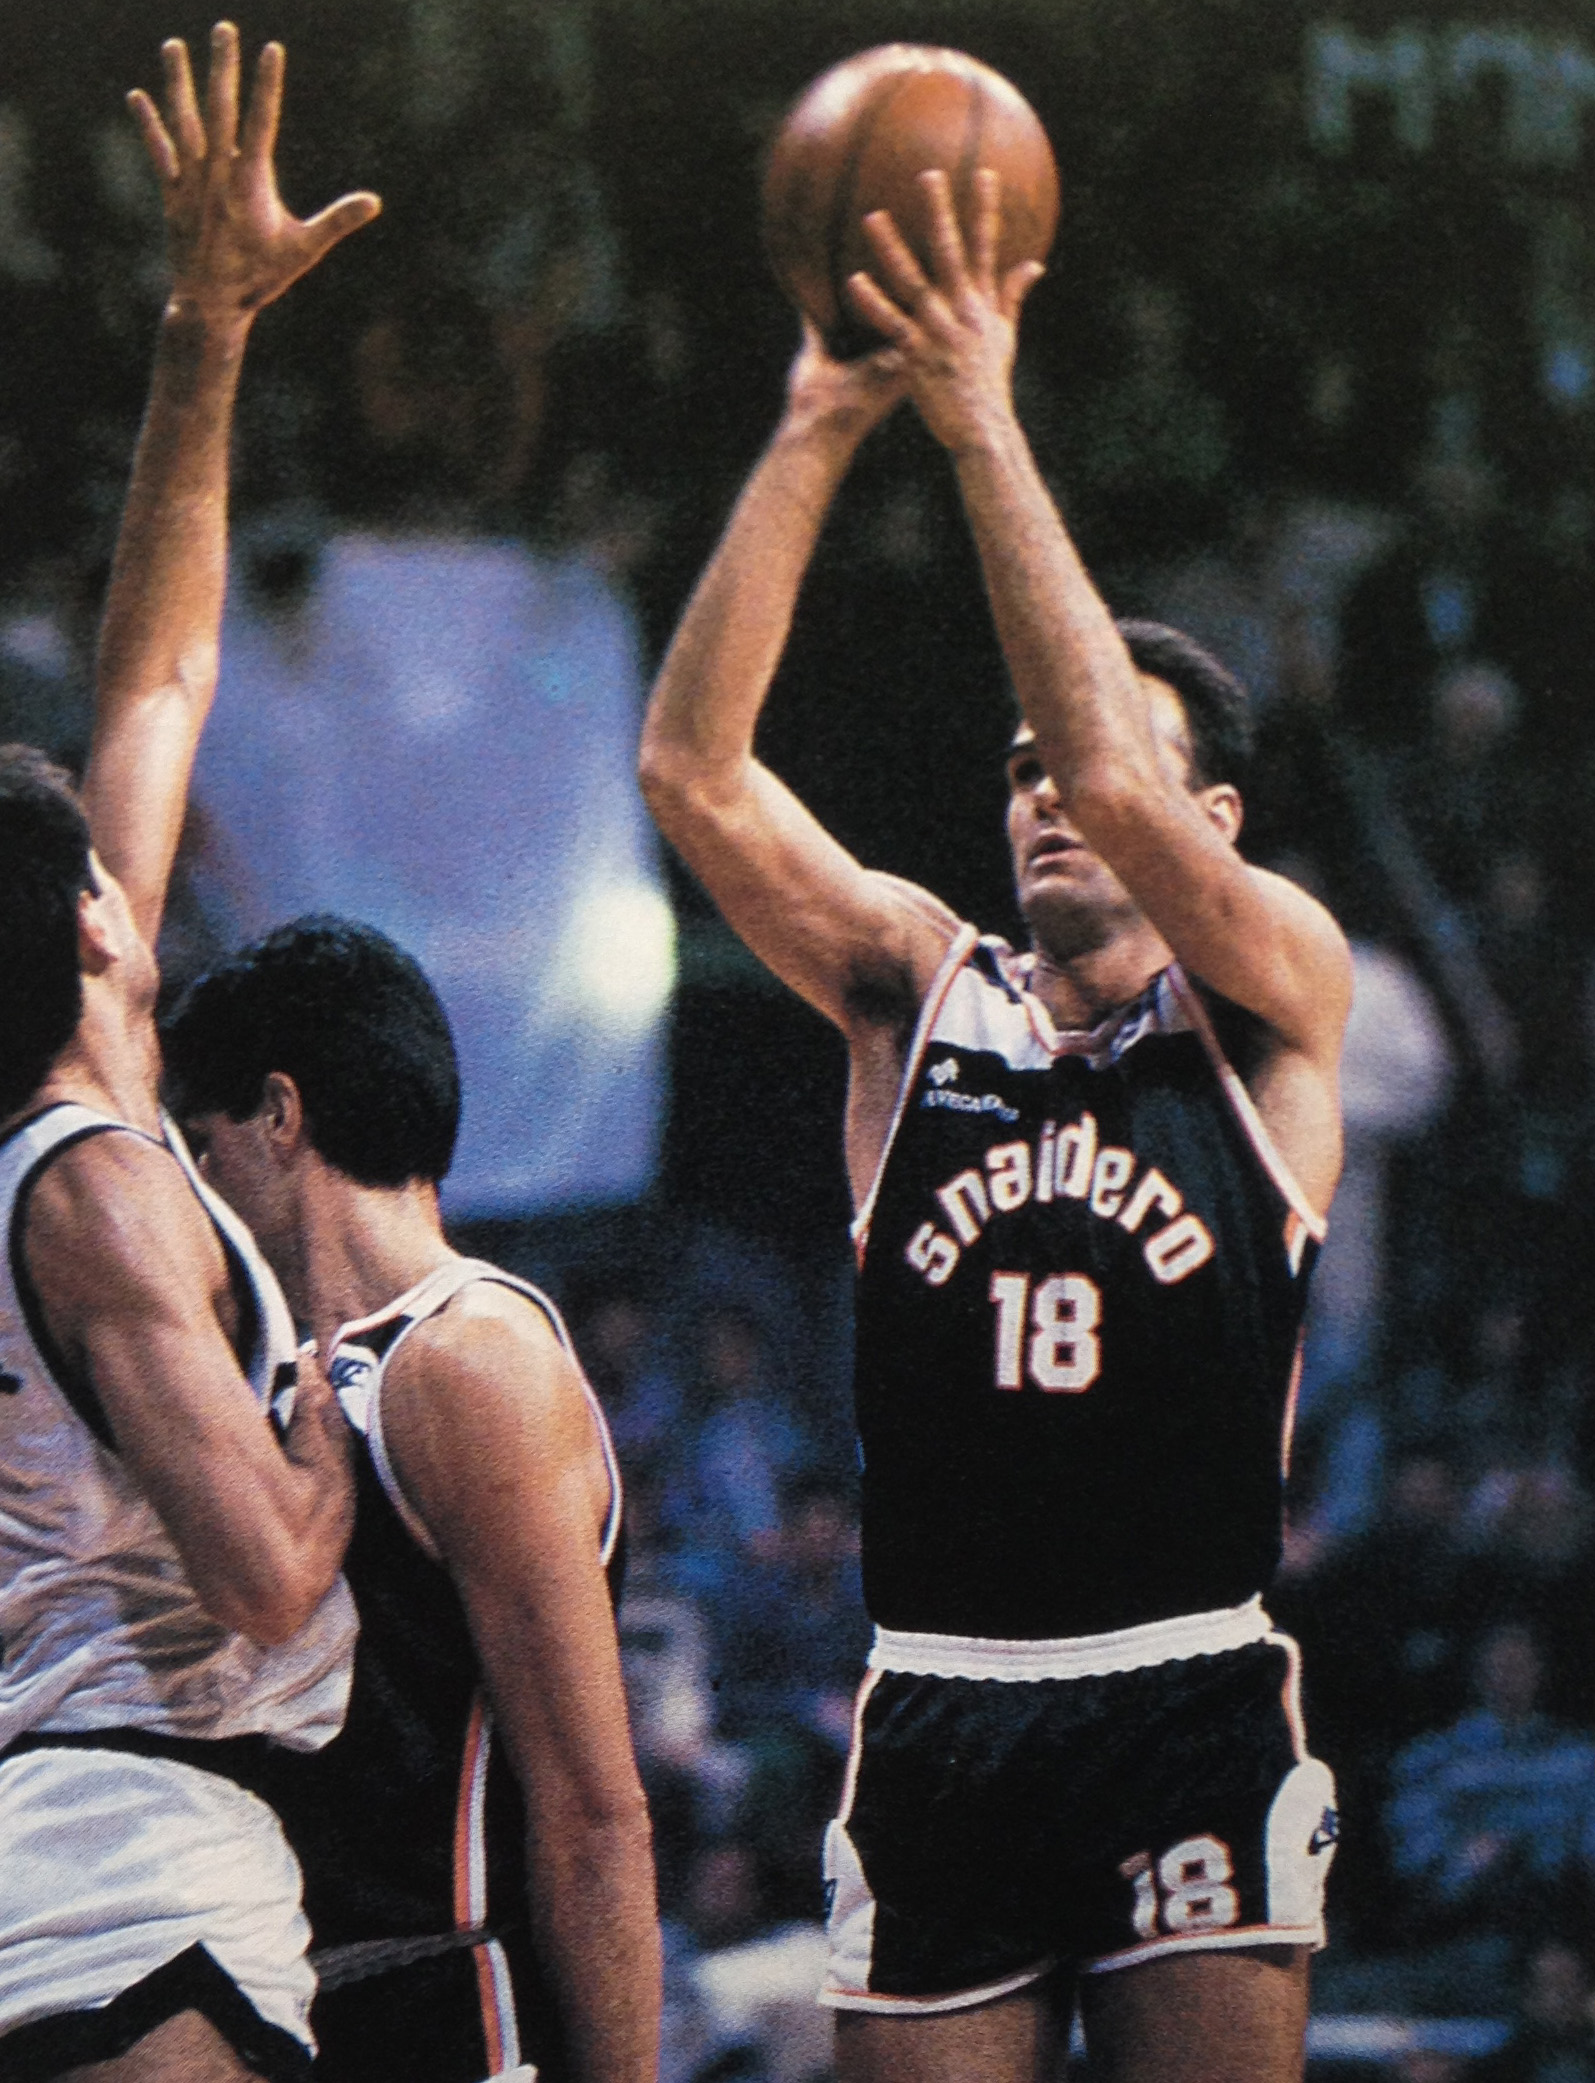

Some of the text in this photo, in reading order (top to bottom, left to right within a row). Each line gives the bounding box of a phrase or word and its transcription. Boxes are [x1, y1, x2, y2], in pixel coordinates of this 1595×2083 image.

[905, 1111, 1216, 1286] snaidero
[989, 1269, 1102, 1393] 18
[1118, 1832, 1241, 1939] 18
